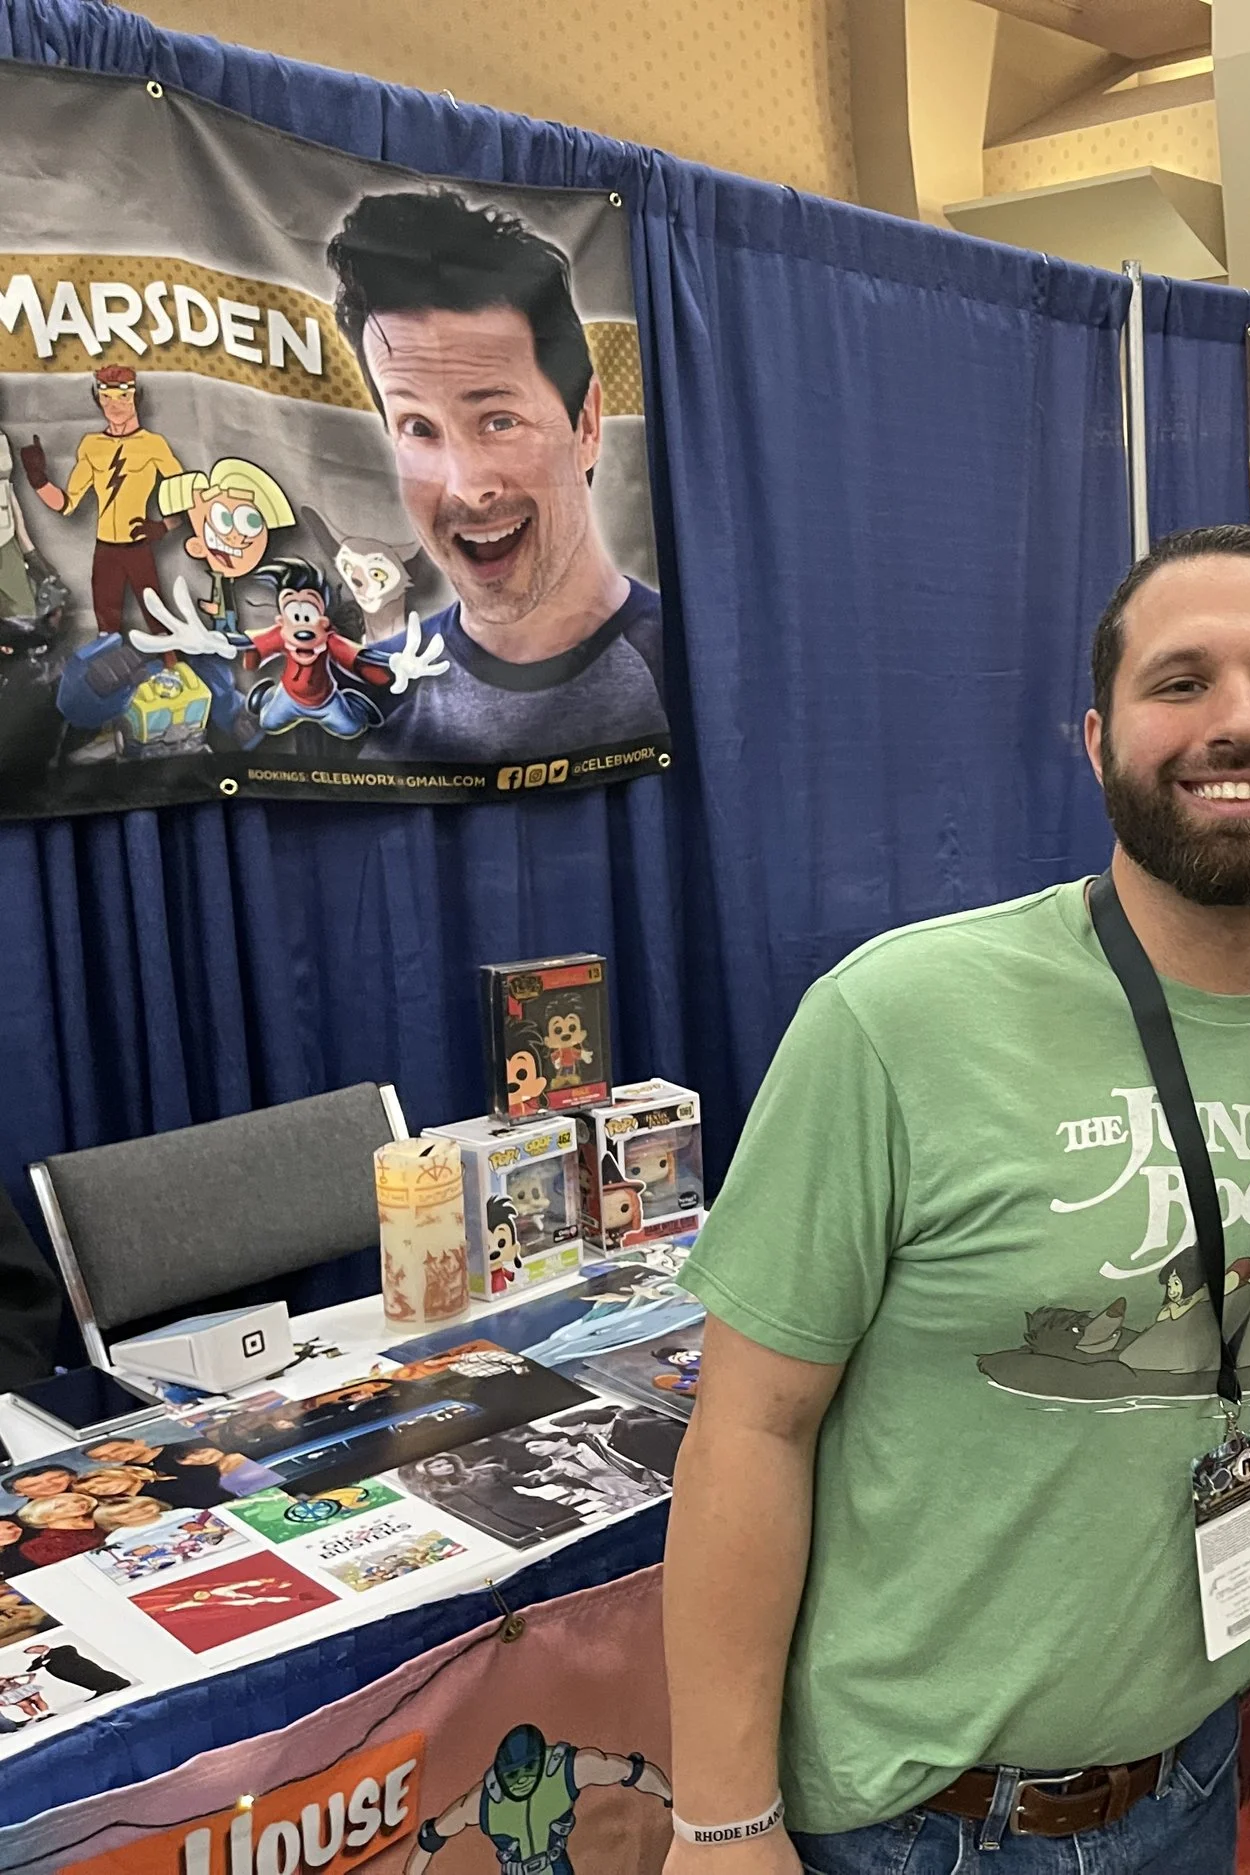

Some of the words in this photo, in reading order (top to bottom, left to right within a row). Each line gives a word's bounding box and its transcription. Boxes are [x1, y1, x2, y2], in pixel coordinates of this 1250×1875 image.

[0, 274, 323, 375] MARSDEN
[1056, 1115, 1129, 1152] THE
[694, 1826, 742, 1842] RHODE
